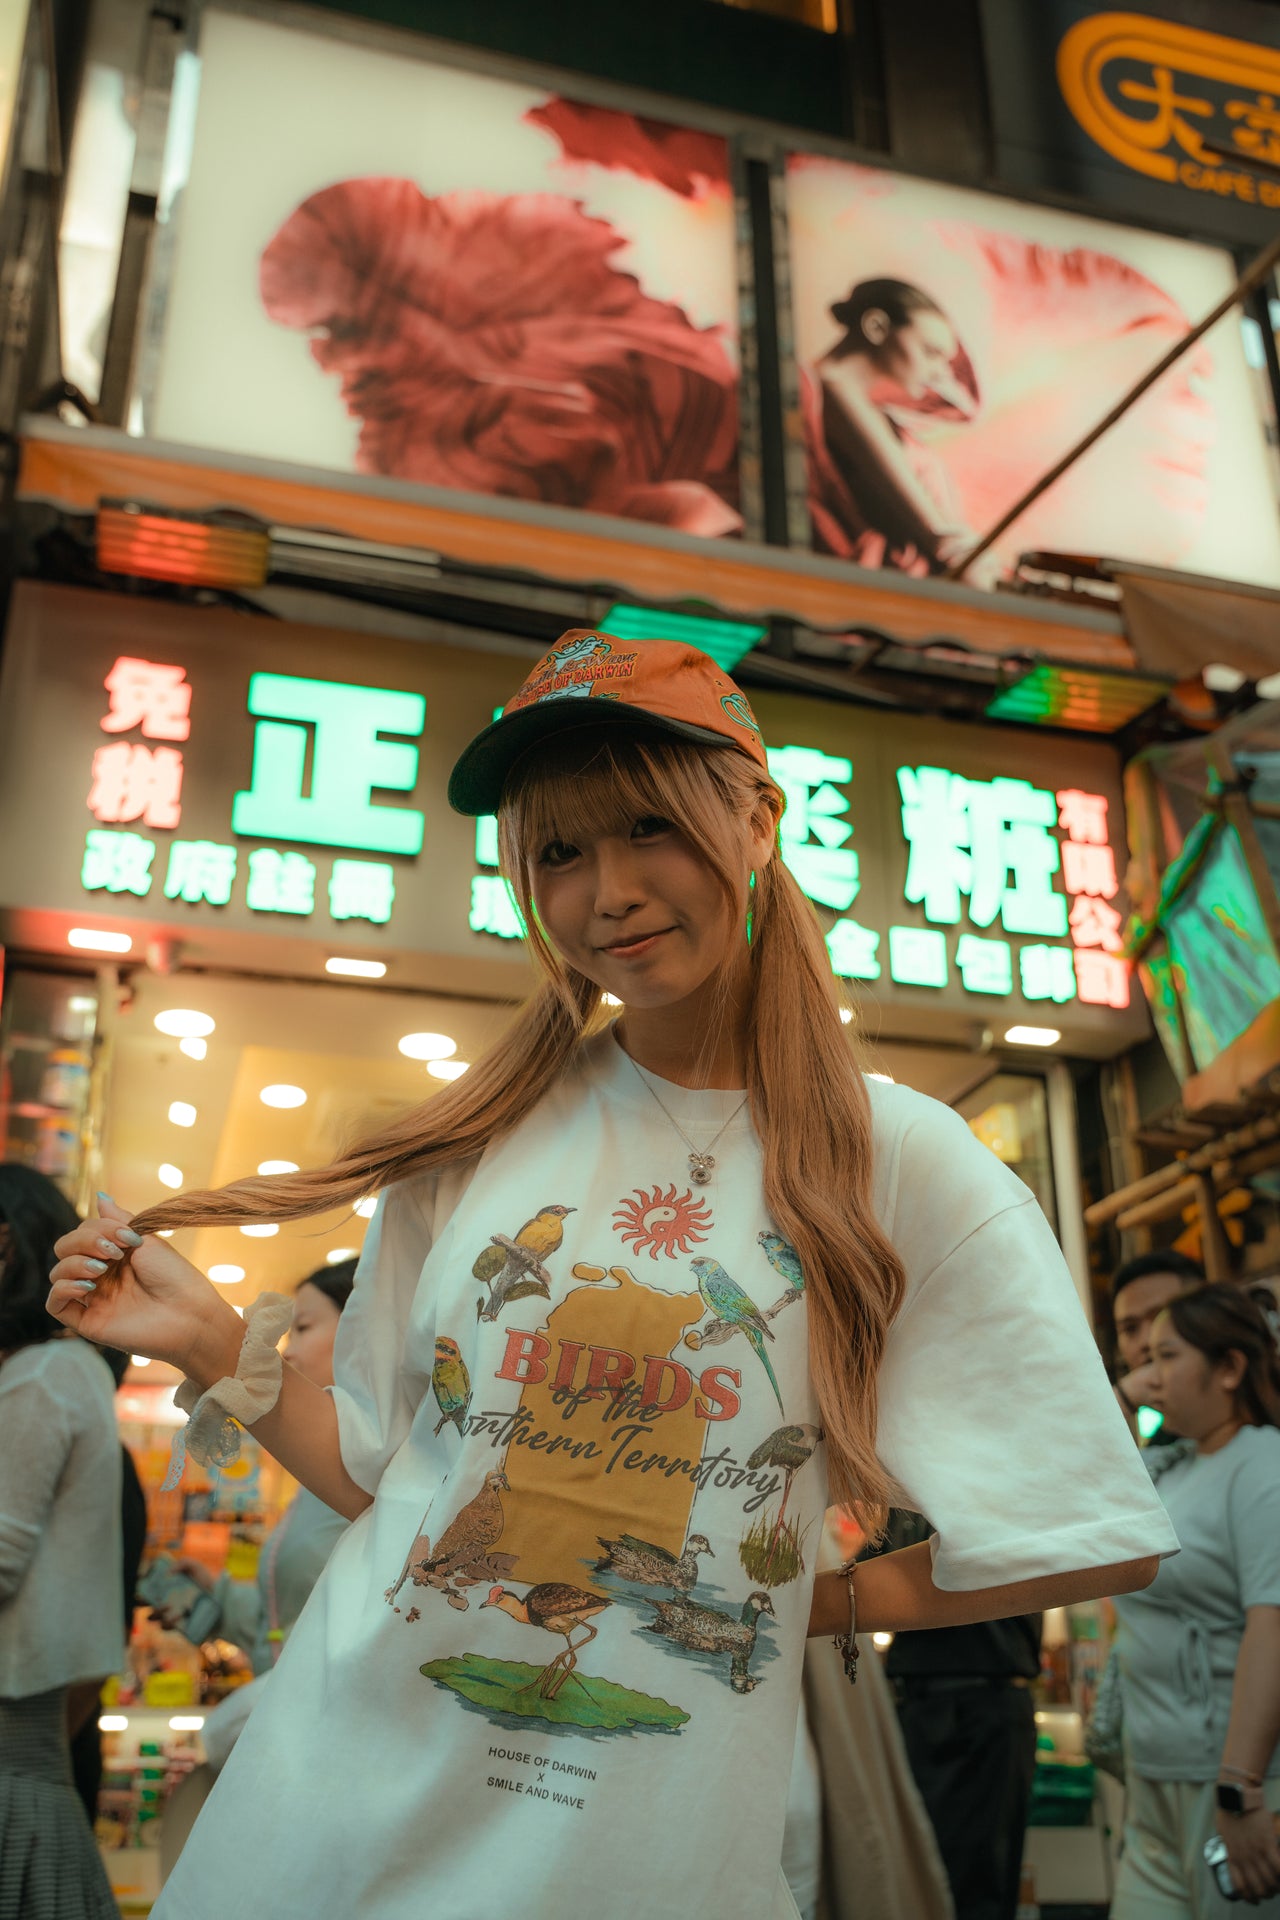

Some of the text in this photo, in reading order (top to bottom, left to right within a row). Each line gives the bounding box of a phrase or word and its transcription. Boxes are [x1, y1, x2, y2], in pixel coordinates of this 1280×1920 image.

[555, 672, 573, 690] OF
[574, 662, 635, 684] DARWIN
[495, 1327, 742, 1422] BIRDS
[551, 1380, 664, 1423] of the
[605, 1424, 782, 1513] Territory
[488, 1746, 598, 1781] HOUSE OF DARWIN
[486, 1776, 586, 1810] SMILE AND WAVE
